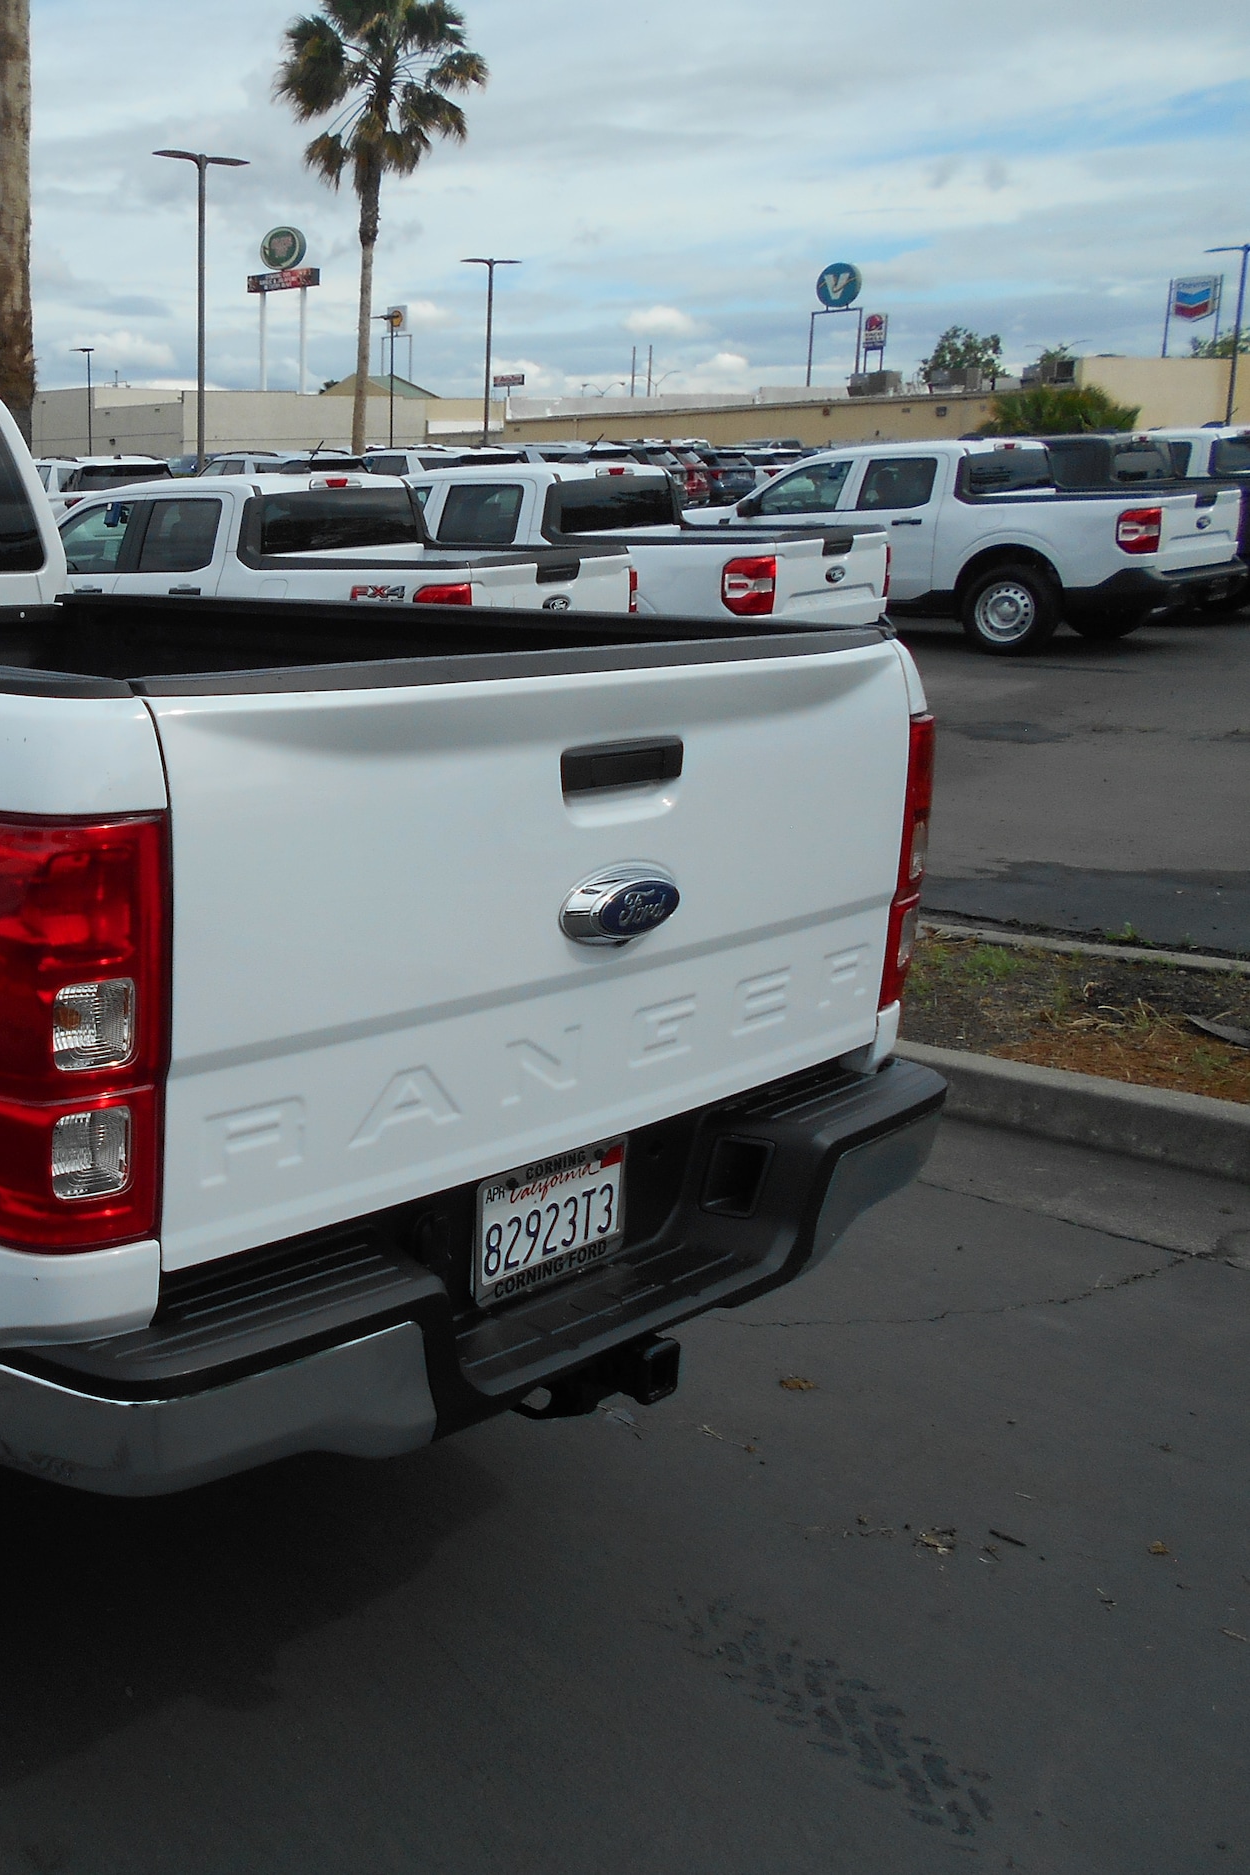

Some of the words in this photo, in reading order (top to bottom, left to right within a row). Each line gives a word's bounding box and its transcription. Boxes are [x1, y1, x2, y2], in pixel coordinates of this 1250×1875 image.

[350, 585, 406, 601] FX4
[618, 888, 667, 926] Ford
[199, 942, 872, 1187] RANGER
[510, 1162, 600, 1204] California
[525, 1150, 587, 1181] CORNING
[485, 1186, 505, 1204] APR
[484, 1183, 614, 1277] 82923T3
[494, 1257, 564, 1299] CORNING
[568, 1239, 607, 1269] FORD
